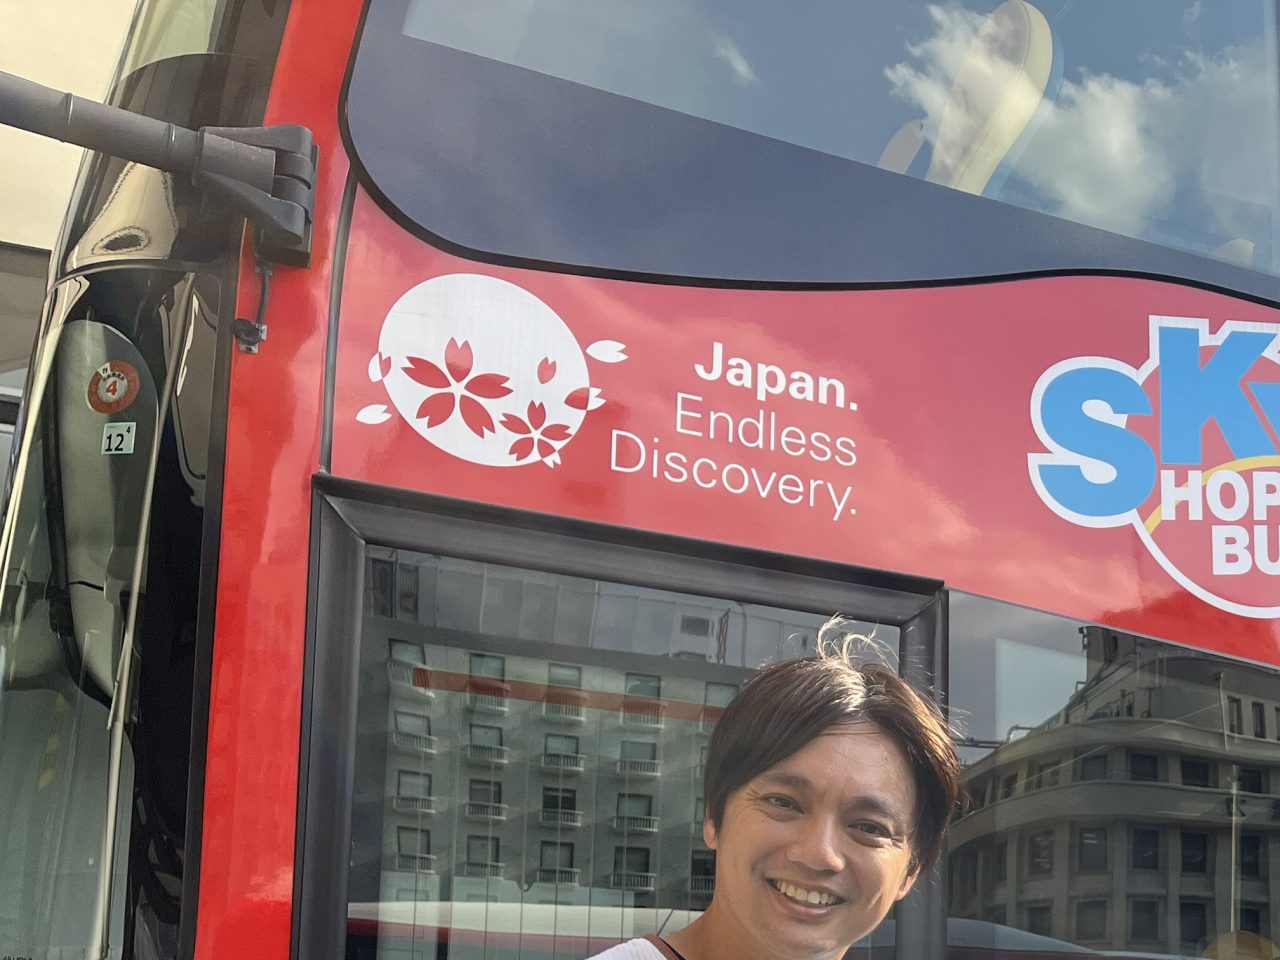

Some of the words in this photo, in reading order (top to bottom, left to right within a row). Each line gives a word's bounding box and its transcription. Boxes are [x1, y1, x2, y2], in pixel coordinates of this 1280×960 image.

[105, 380, 118, 396] 4
[694, 341, 858, 411] Japan.
[105, 433, 124, 452] 12
[676, 391, 857, 446] Endless
[610, 428, 857, 521] Discovery.
